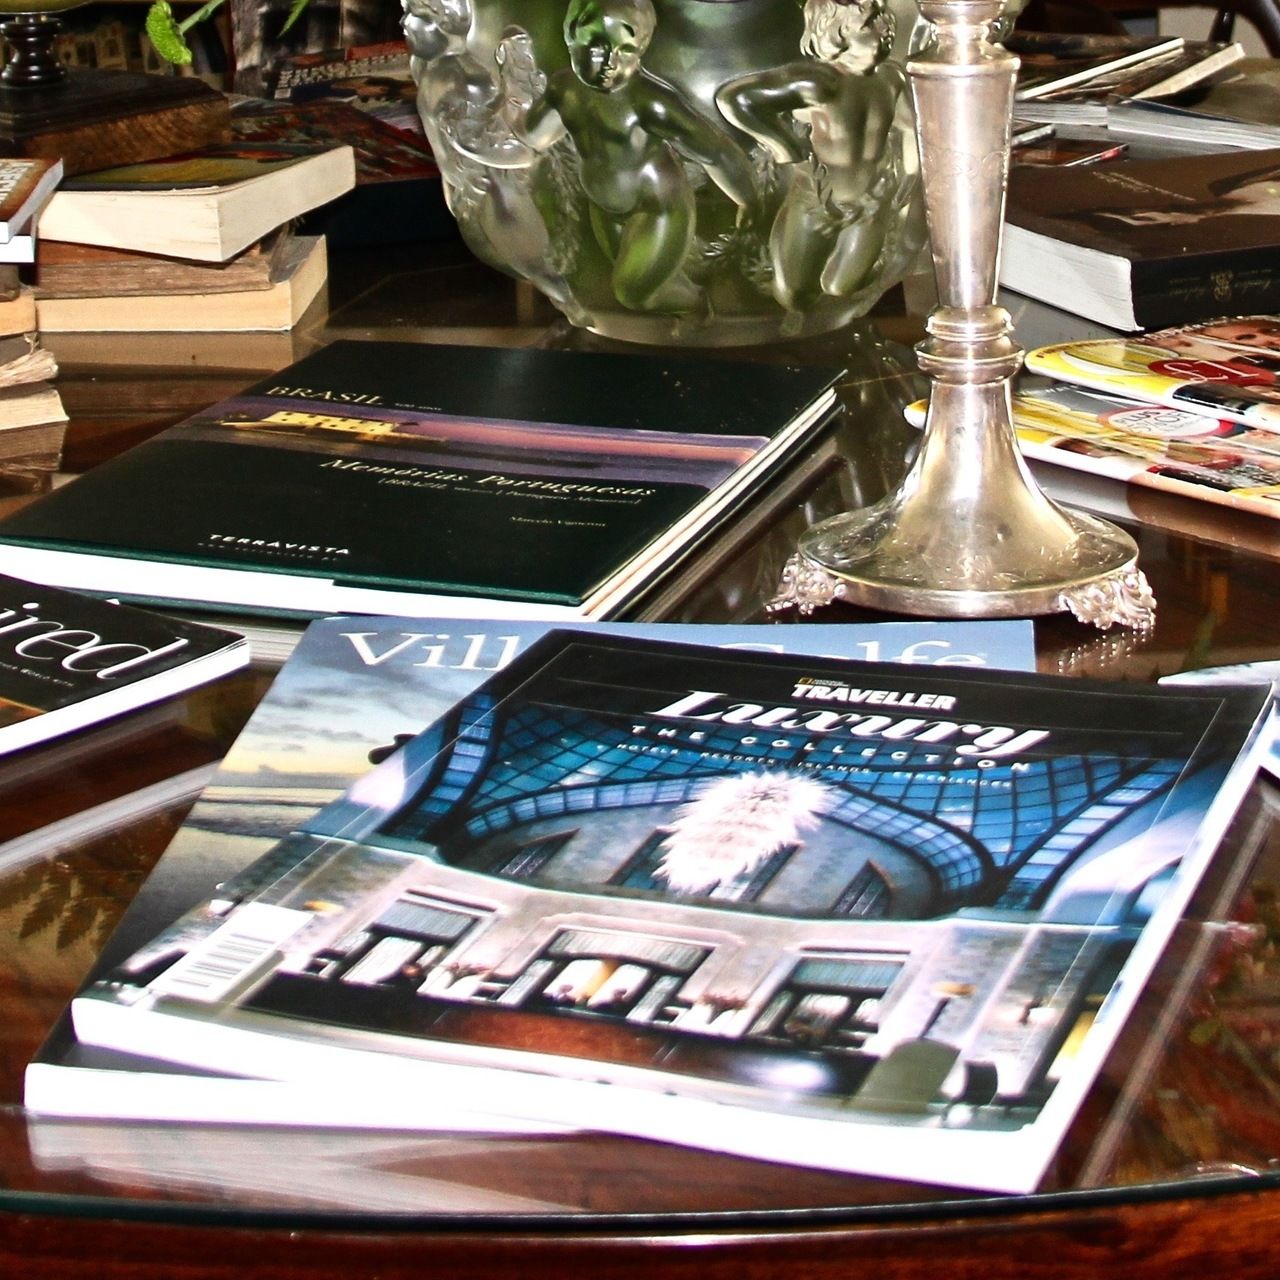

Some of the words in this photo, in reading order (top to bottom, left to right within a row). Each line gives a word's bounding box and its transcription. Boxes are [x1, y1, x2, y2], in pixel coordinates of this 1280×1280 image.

[263, 386, 385, 407] BRASIL
[319, 456, 470, 484] Memórias
[475, 474, 657, 496] Portuguesas
[209, 533, 352, 555] TERRAVISTA
[339, 631, 521, 671] Vill
[790, 683, 958, 712] TRAVELLER
[643, 689, 1052, 757] Luxury
[631, 723, 708, 742] THE
[739, 735, 1033, 773] COLLECTION
